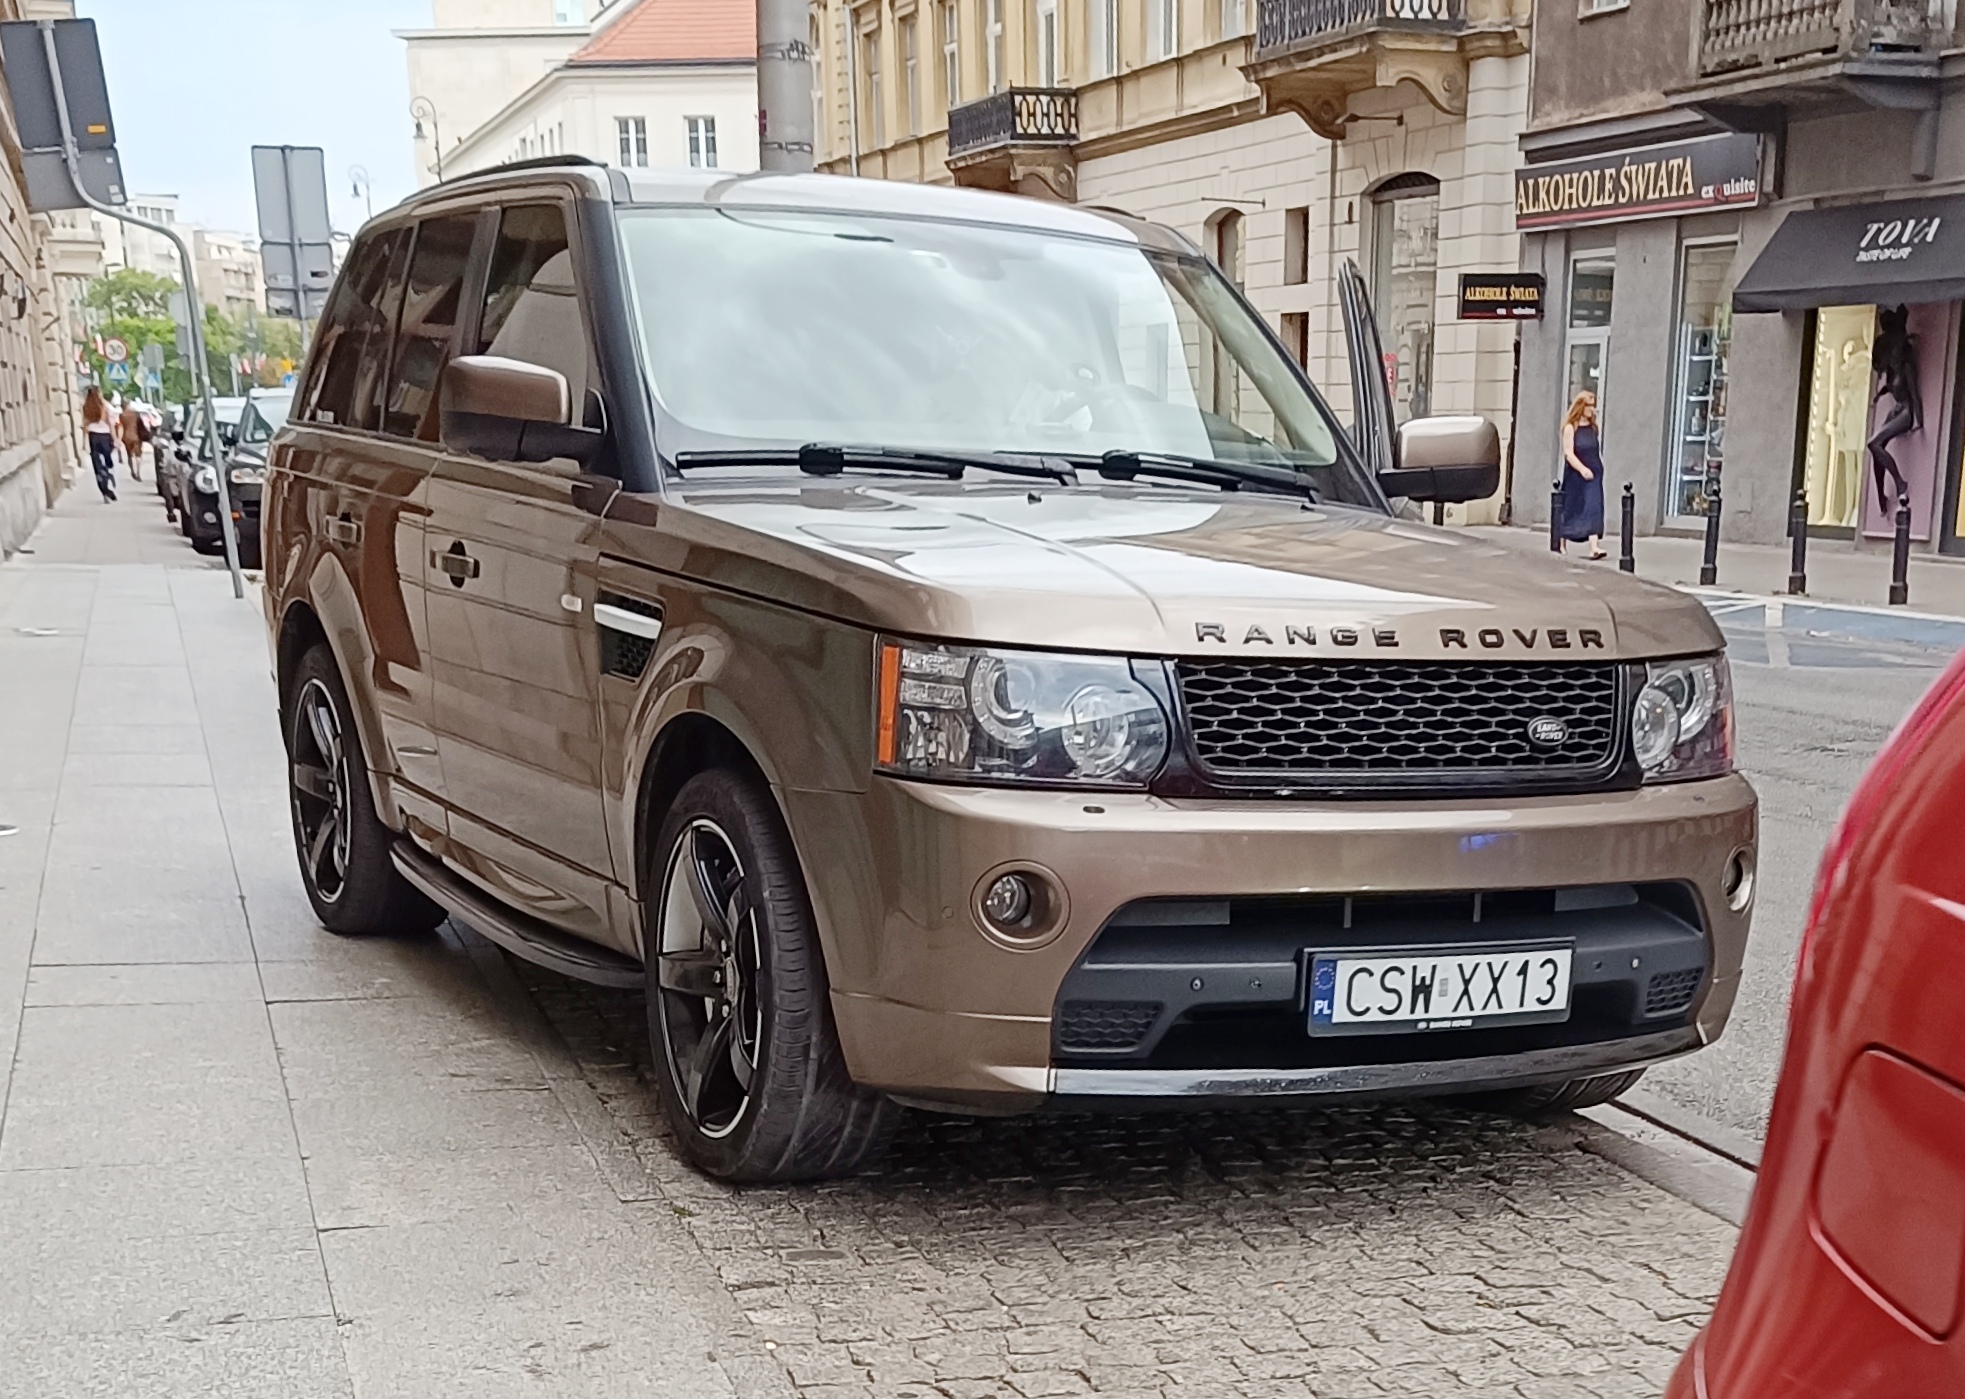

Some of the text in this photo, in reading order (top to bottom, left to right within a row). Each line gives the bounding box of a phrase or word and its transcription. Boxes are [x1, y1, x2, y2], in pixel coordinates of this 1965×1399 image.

[1516, 156, 1695, 214] ALKOHOLE ŚWIATA
[1860, 217, 1941, 248] TOVA
[1465, 284, 1539, 301] ALKOHOLE ŚWIATA
[1195, 622, 1605, 649] RANGE ROVER
[1346, 957, 1559, 1017] CSW XX13
[1313, 1000, 1332, 1015] PL
